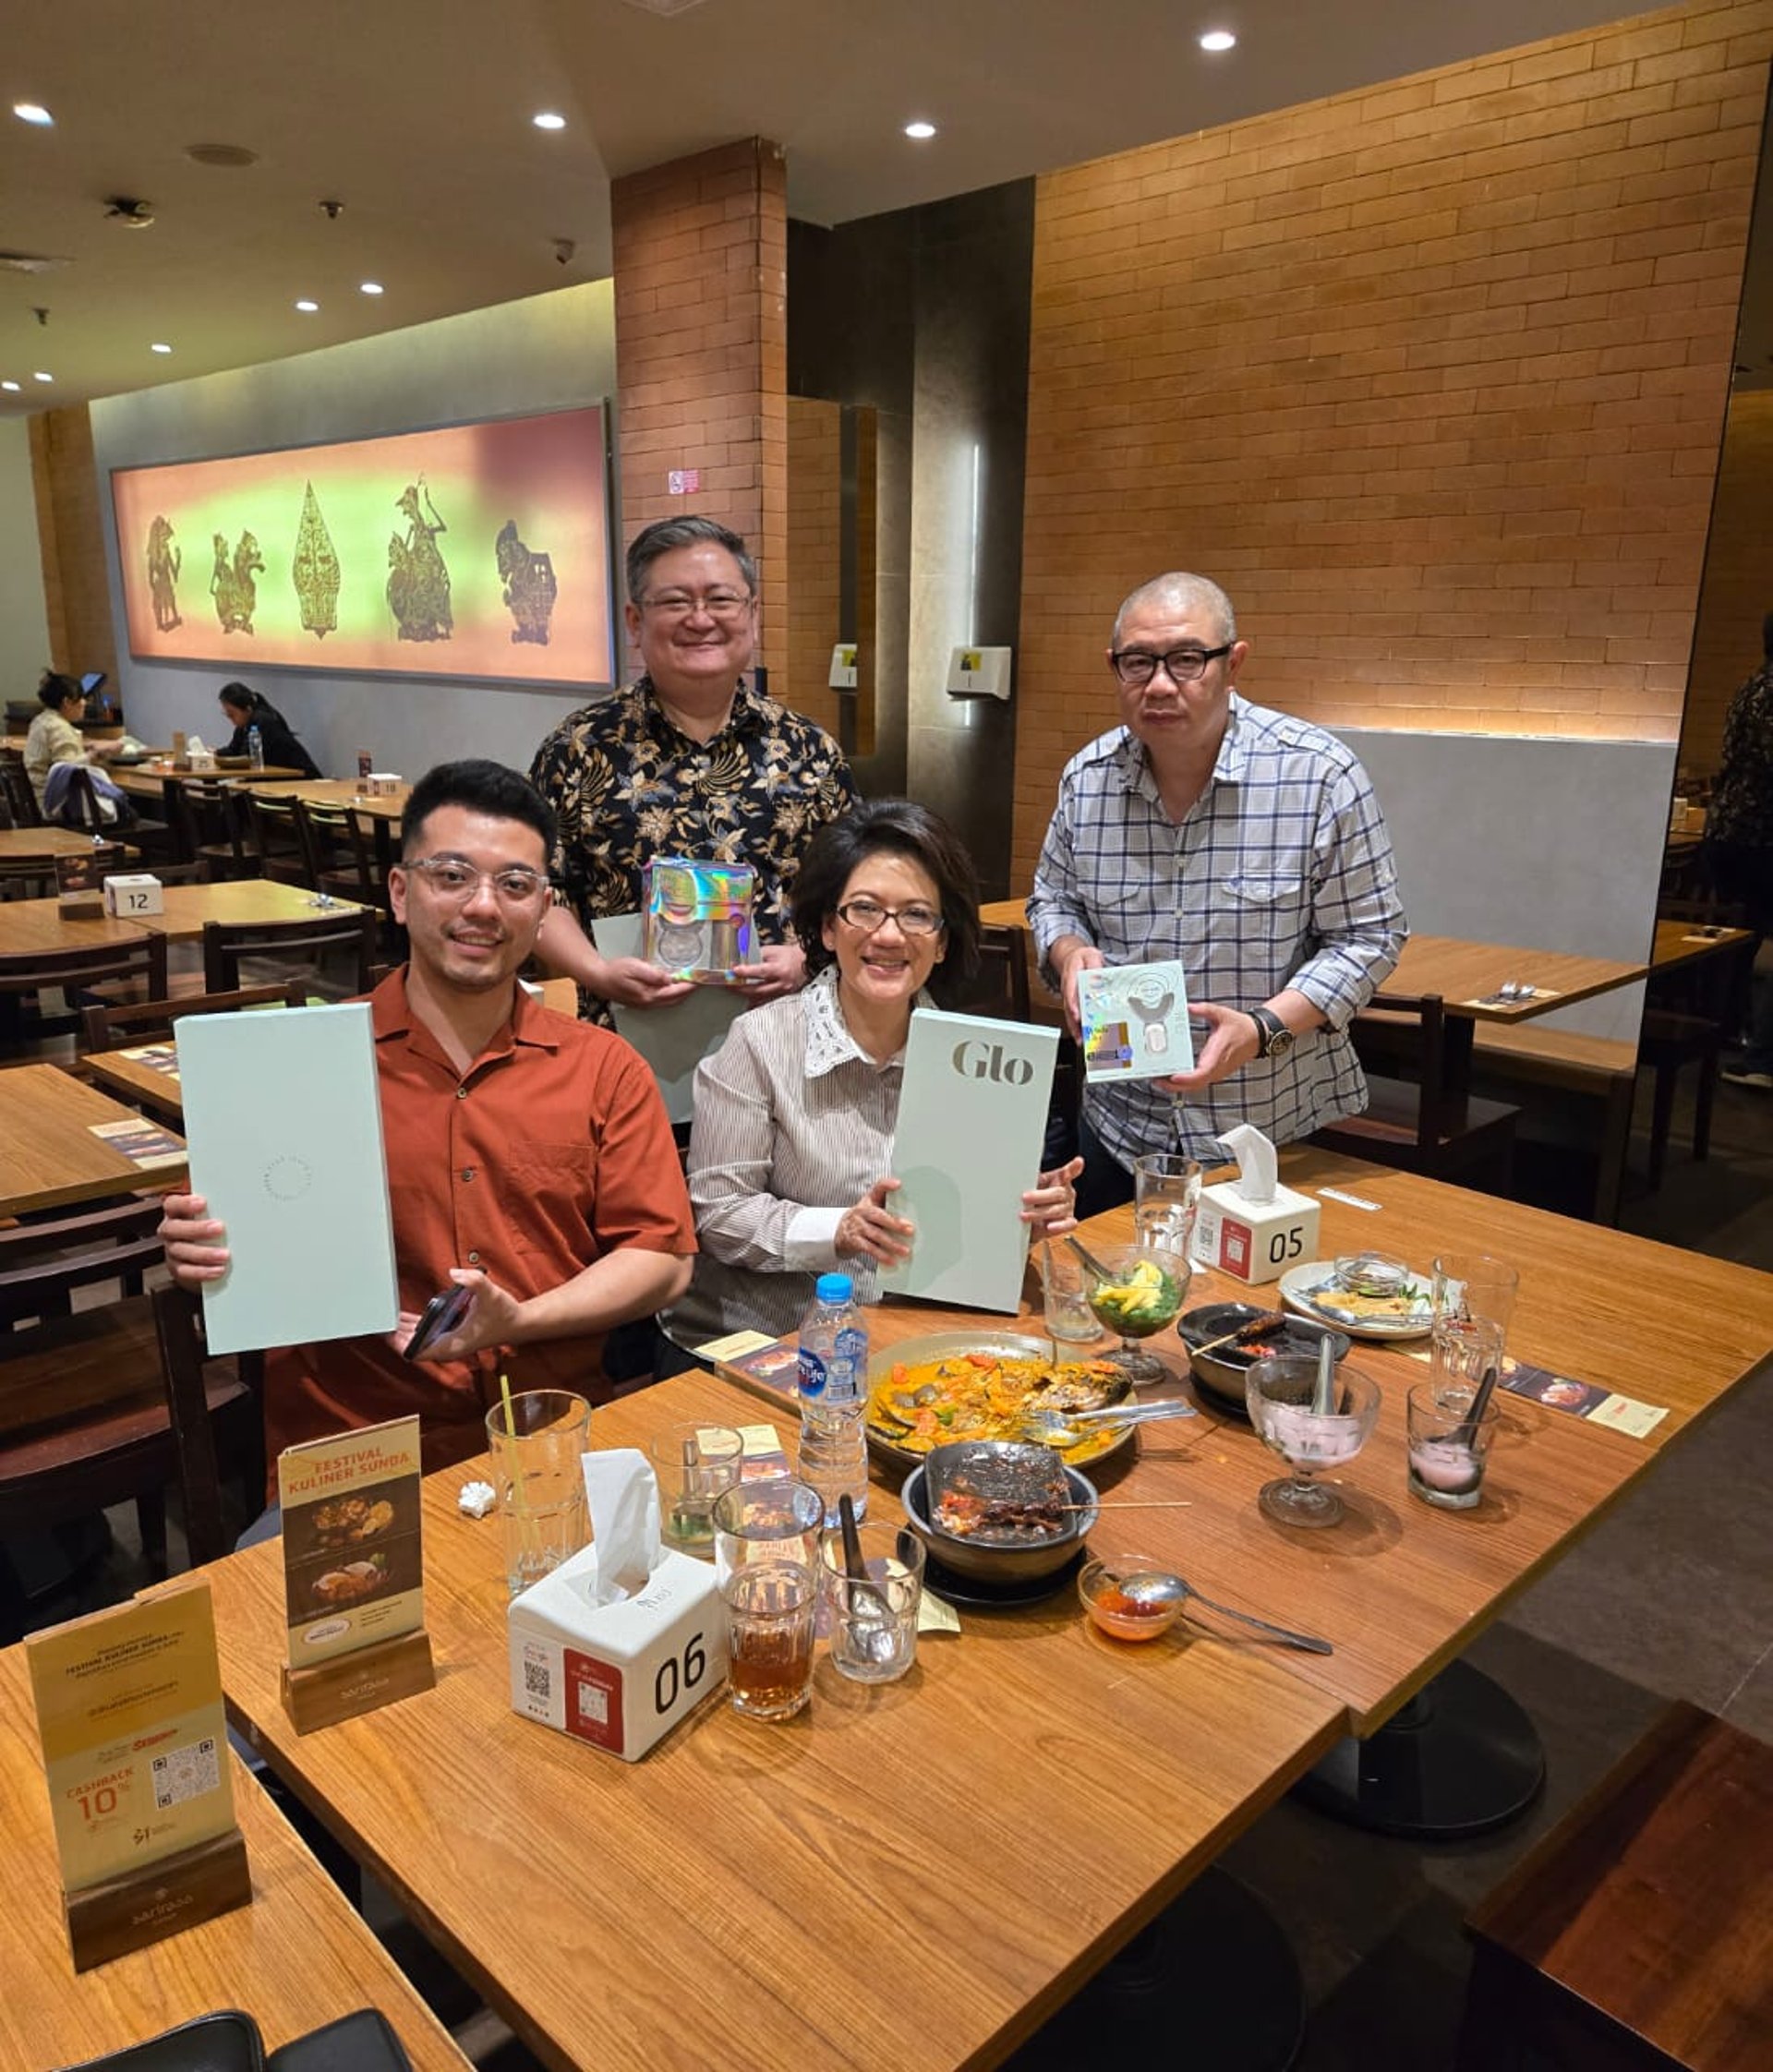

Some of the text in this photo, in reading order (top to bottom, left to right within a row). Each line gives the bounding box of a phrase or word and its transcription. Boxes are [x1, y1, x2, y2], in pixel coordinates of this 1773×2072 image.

[128, 893, 149, 910] 12
[952, 1039, 1034, 1086] Glo
[1269, 1225, 1304, 1264] 05
[288, 1451, 410, 1495] KULINER SUNDA
[314, 1446, 383, 1474] FESTIVAL
[654, 1631, 706, 1715] 06
[66, 1765, 135, 1800] CASHBACK
